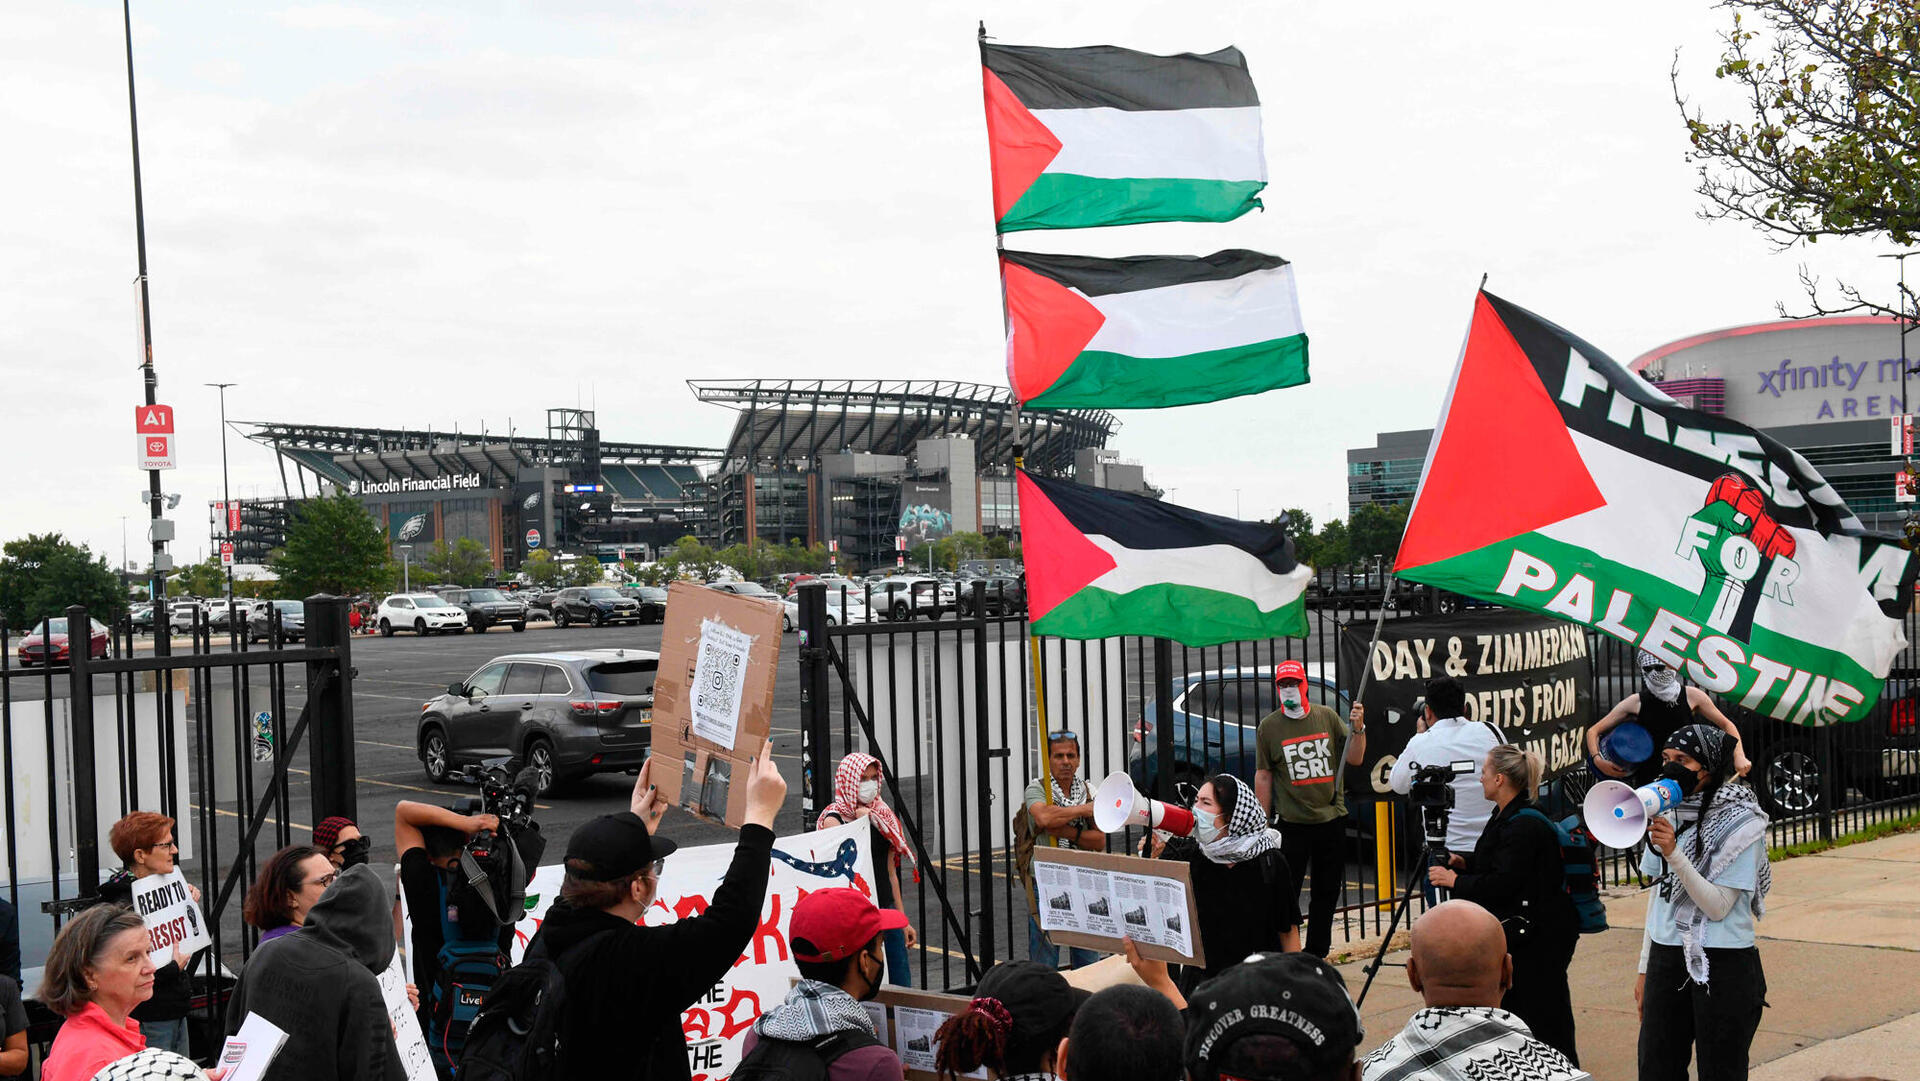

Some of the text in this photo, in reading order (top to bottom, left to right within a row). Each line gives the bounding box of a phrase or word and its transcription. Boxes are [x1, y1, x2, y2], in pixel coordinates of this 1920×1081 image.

[1758, 355, 1868, 398] xfinity
[144, 409, 166, 426] A1
[1816, 395, 1920, 420] AREN
[361, 473, 480, 494] Lincoln Financial Field
[1675, 516, 1800, 606] FOR
[1369, 623, 1587, 681] DAY & ZIMMERMAN
[1532, 677, 1576, 724] FROM
[1282, 738, 1332, 763] FCK
[1287, 757, 1334, 780] ISRL
[1551, 726, 1584, 772] GAZA
[137, 880, 186, 916] READY TO
[1199, 1004, 1326, 1061] DISCOVER GREATNESS
